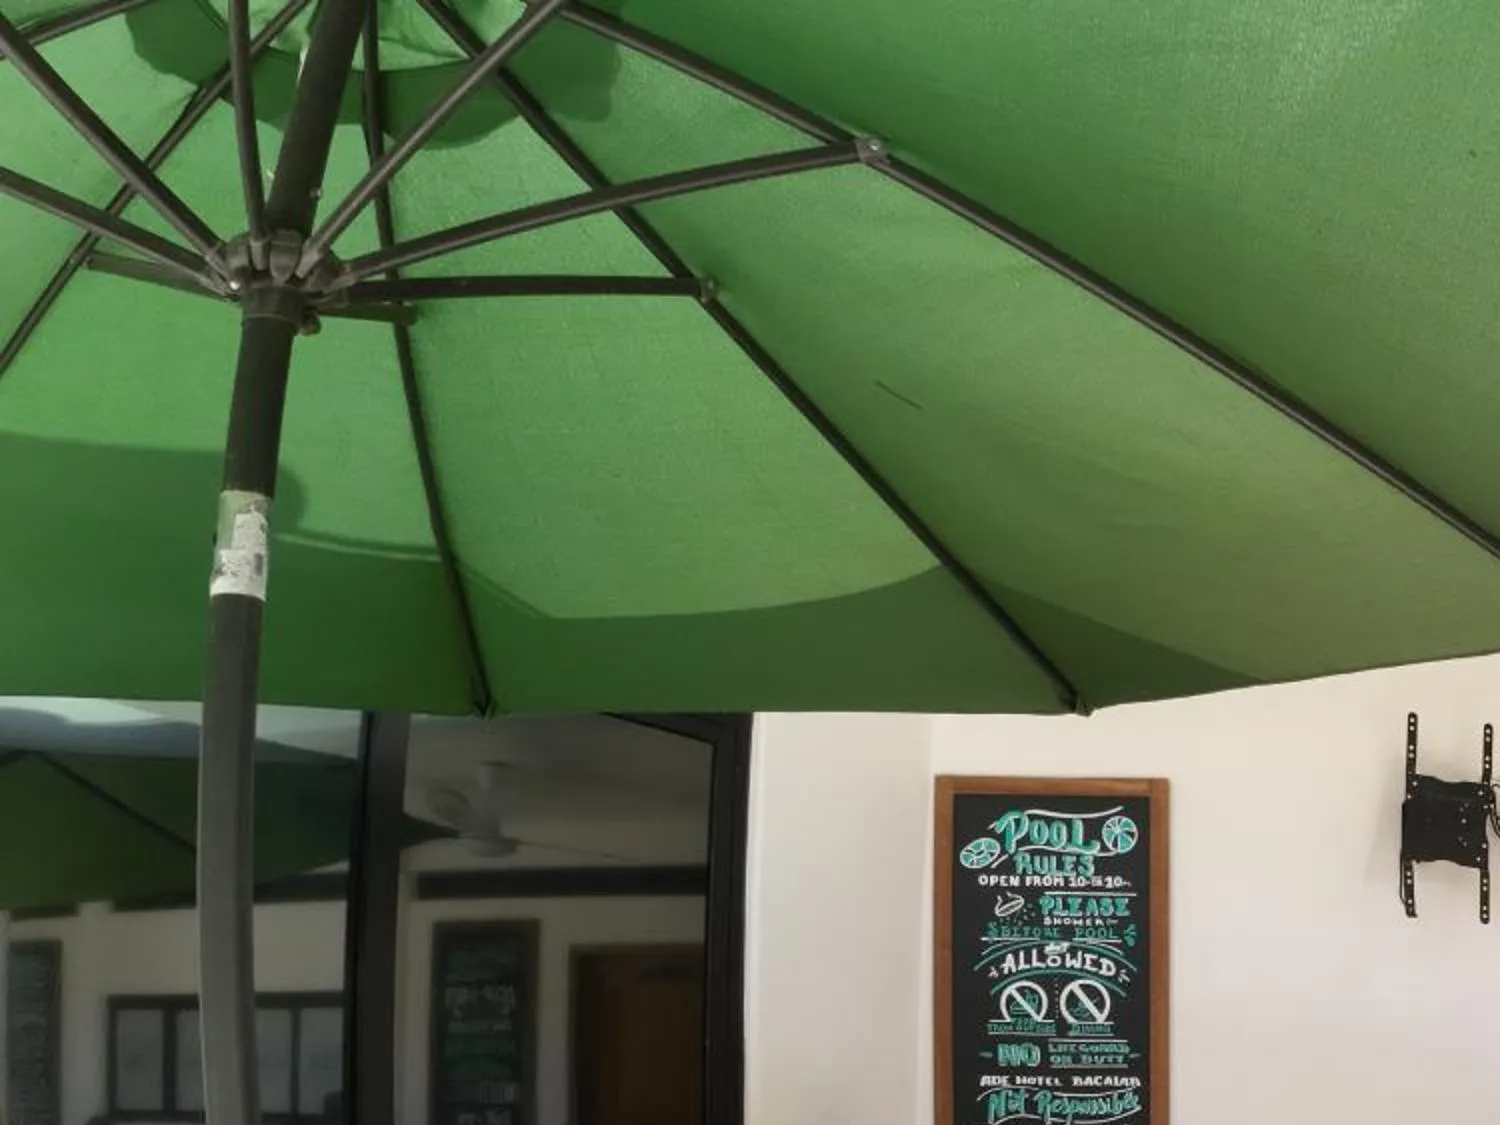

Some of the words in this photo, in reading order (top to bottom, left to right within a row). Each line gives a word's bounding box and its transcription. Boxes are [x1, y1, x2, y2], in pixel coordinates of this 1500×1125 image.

[1014, 852, 1095, 877] RULES
[978, 875, 1020, 887] OPEN
[1025, 875, 1064, 887] FROM
[1039, 895, 1131, 917] PLEASE
[1075, 926, 1119, 938] POOL
[1000, 951, 1117, 977] ALLOWED
[997, 1042, 1041, 1067] NO
[1015, 1075, 1063, 1086] HOTEL
[1072, 1074, 1141, 1088] BACALAR
